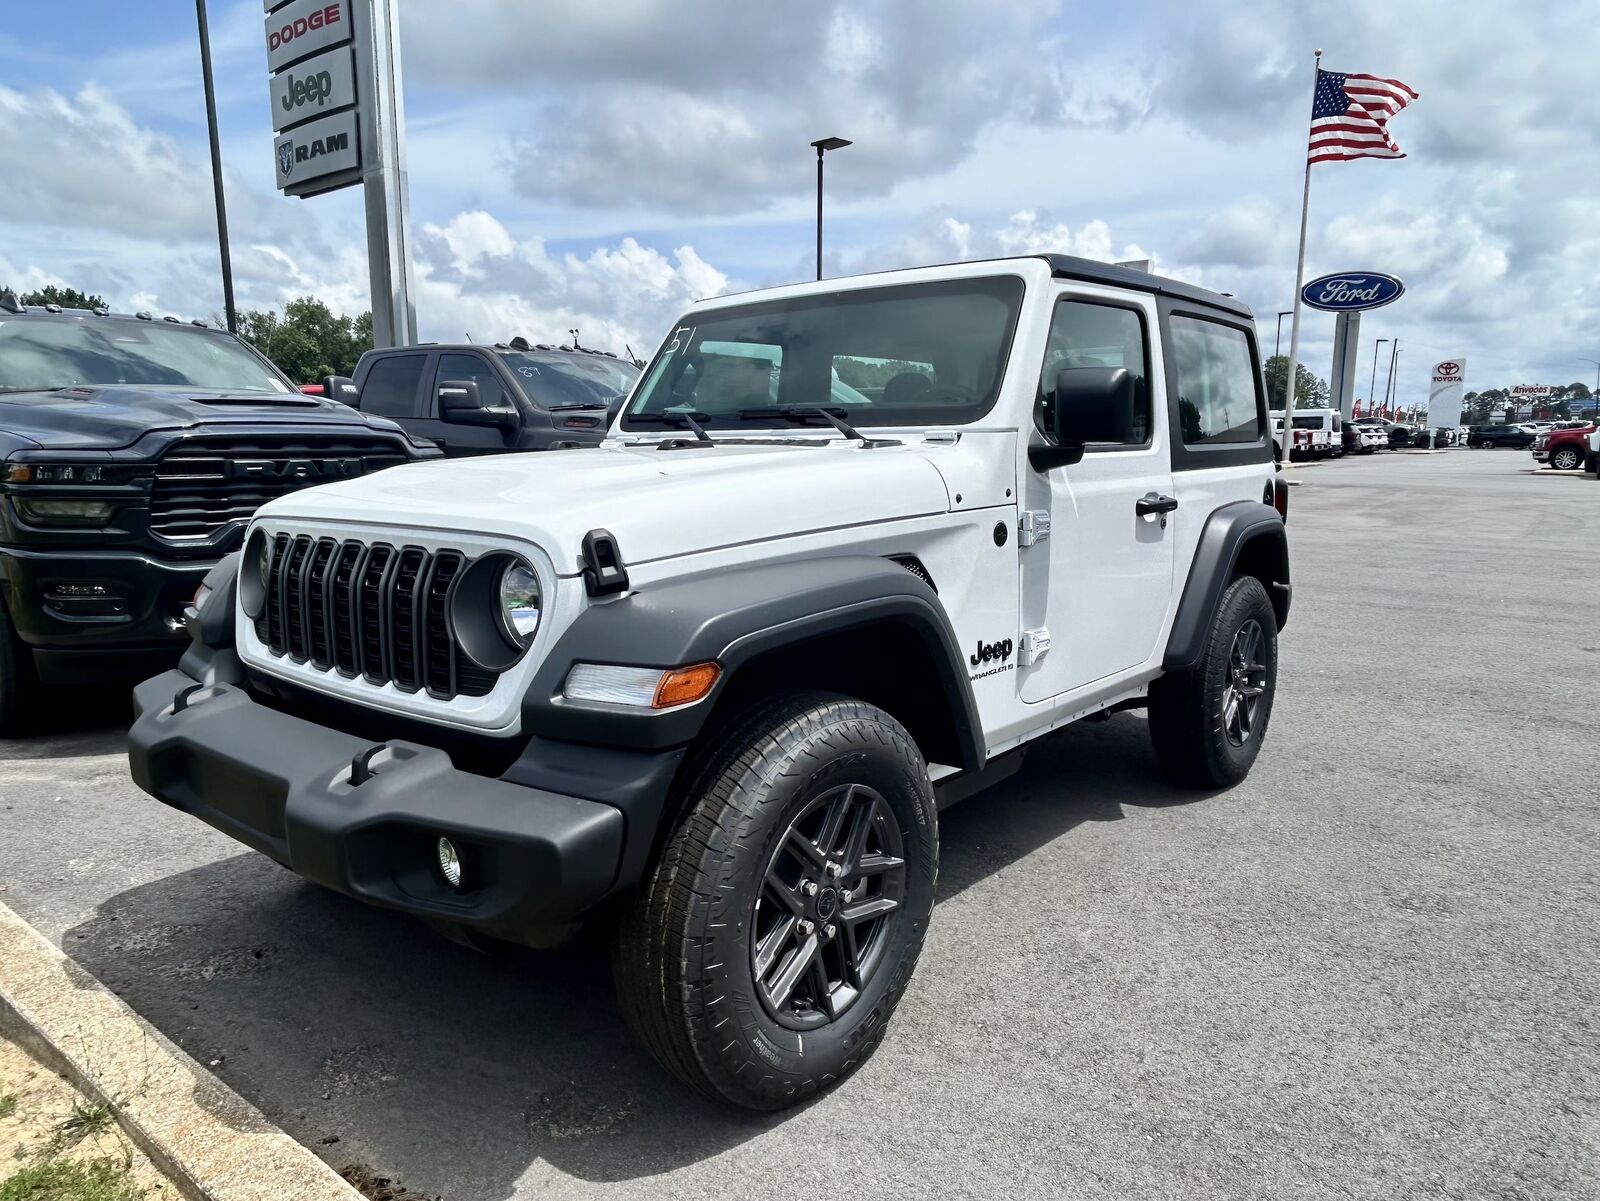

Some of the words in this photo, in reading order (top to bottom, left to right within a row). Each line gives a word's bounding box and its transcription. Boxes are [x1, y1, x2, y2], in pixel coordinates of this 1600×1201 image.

[269, 4, 341, 52] DODGE
[281, 70, 332, 111] Jeep
[295, 132, 348, 163] RAM
[1320, 279, 1381, 302] Ford
[665, 326, 697, 356] 51
[233, 458, 361, 480] RAM
[970, 638, 1013, 666] Jeep
